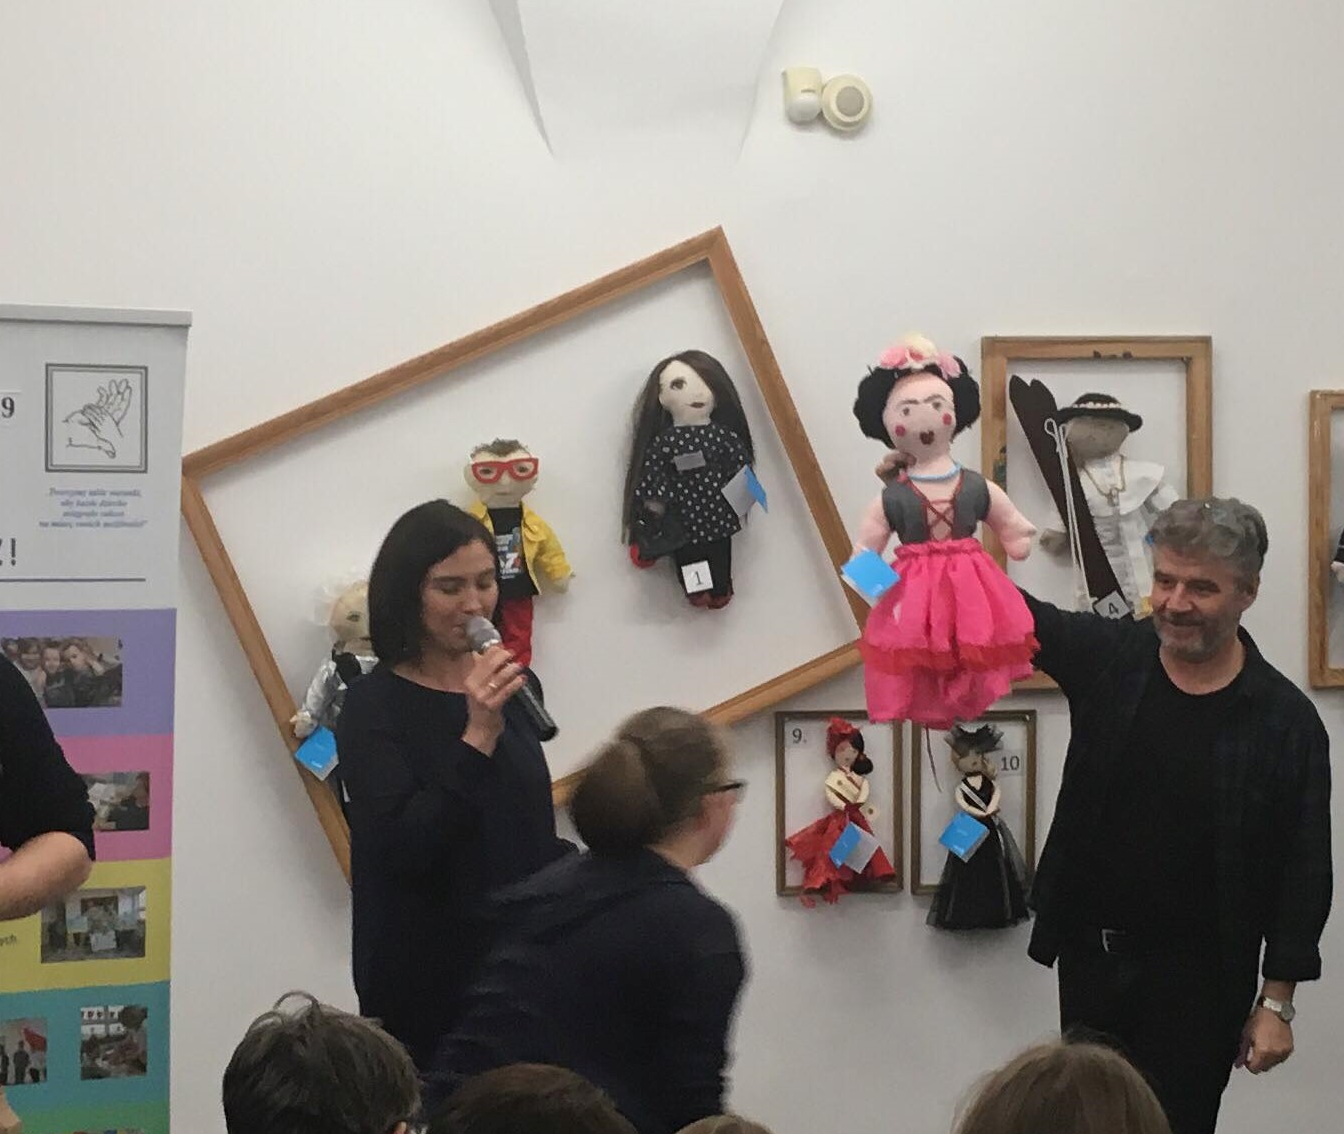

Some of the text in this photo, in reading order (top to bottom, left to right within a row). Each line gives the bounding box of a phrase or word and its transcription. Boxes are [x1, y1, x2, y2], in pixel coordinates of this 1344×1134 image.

[10, 538, 17, 566] !
[695, 570, 704, 586] 1
[1108, 602, 1119, 615] 4
[1000, 756, 1020, 772] 10
